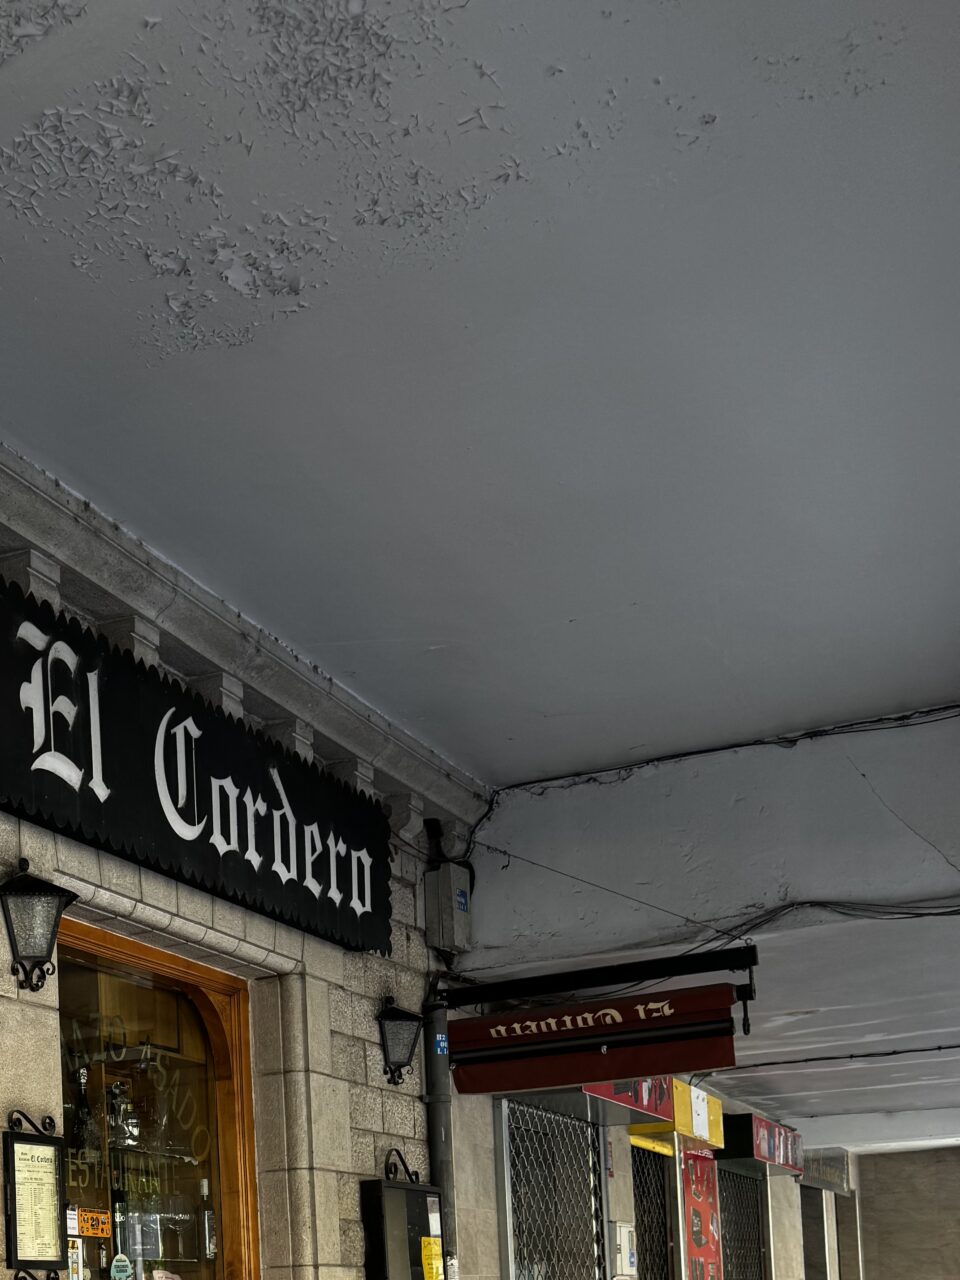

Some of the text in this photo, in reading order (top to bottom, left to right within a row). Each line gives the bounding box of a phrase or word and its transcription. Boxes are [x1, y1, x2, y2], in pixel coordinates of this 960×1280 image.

[16, 621, 110, 803] El
[154, 706, 373, 918] Cordero
[67, 1147, 180, 1197] ESTAURANTE
